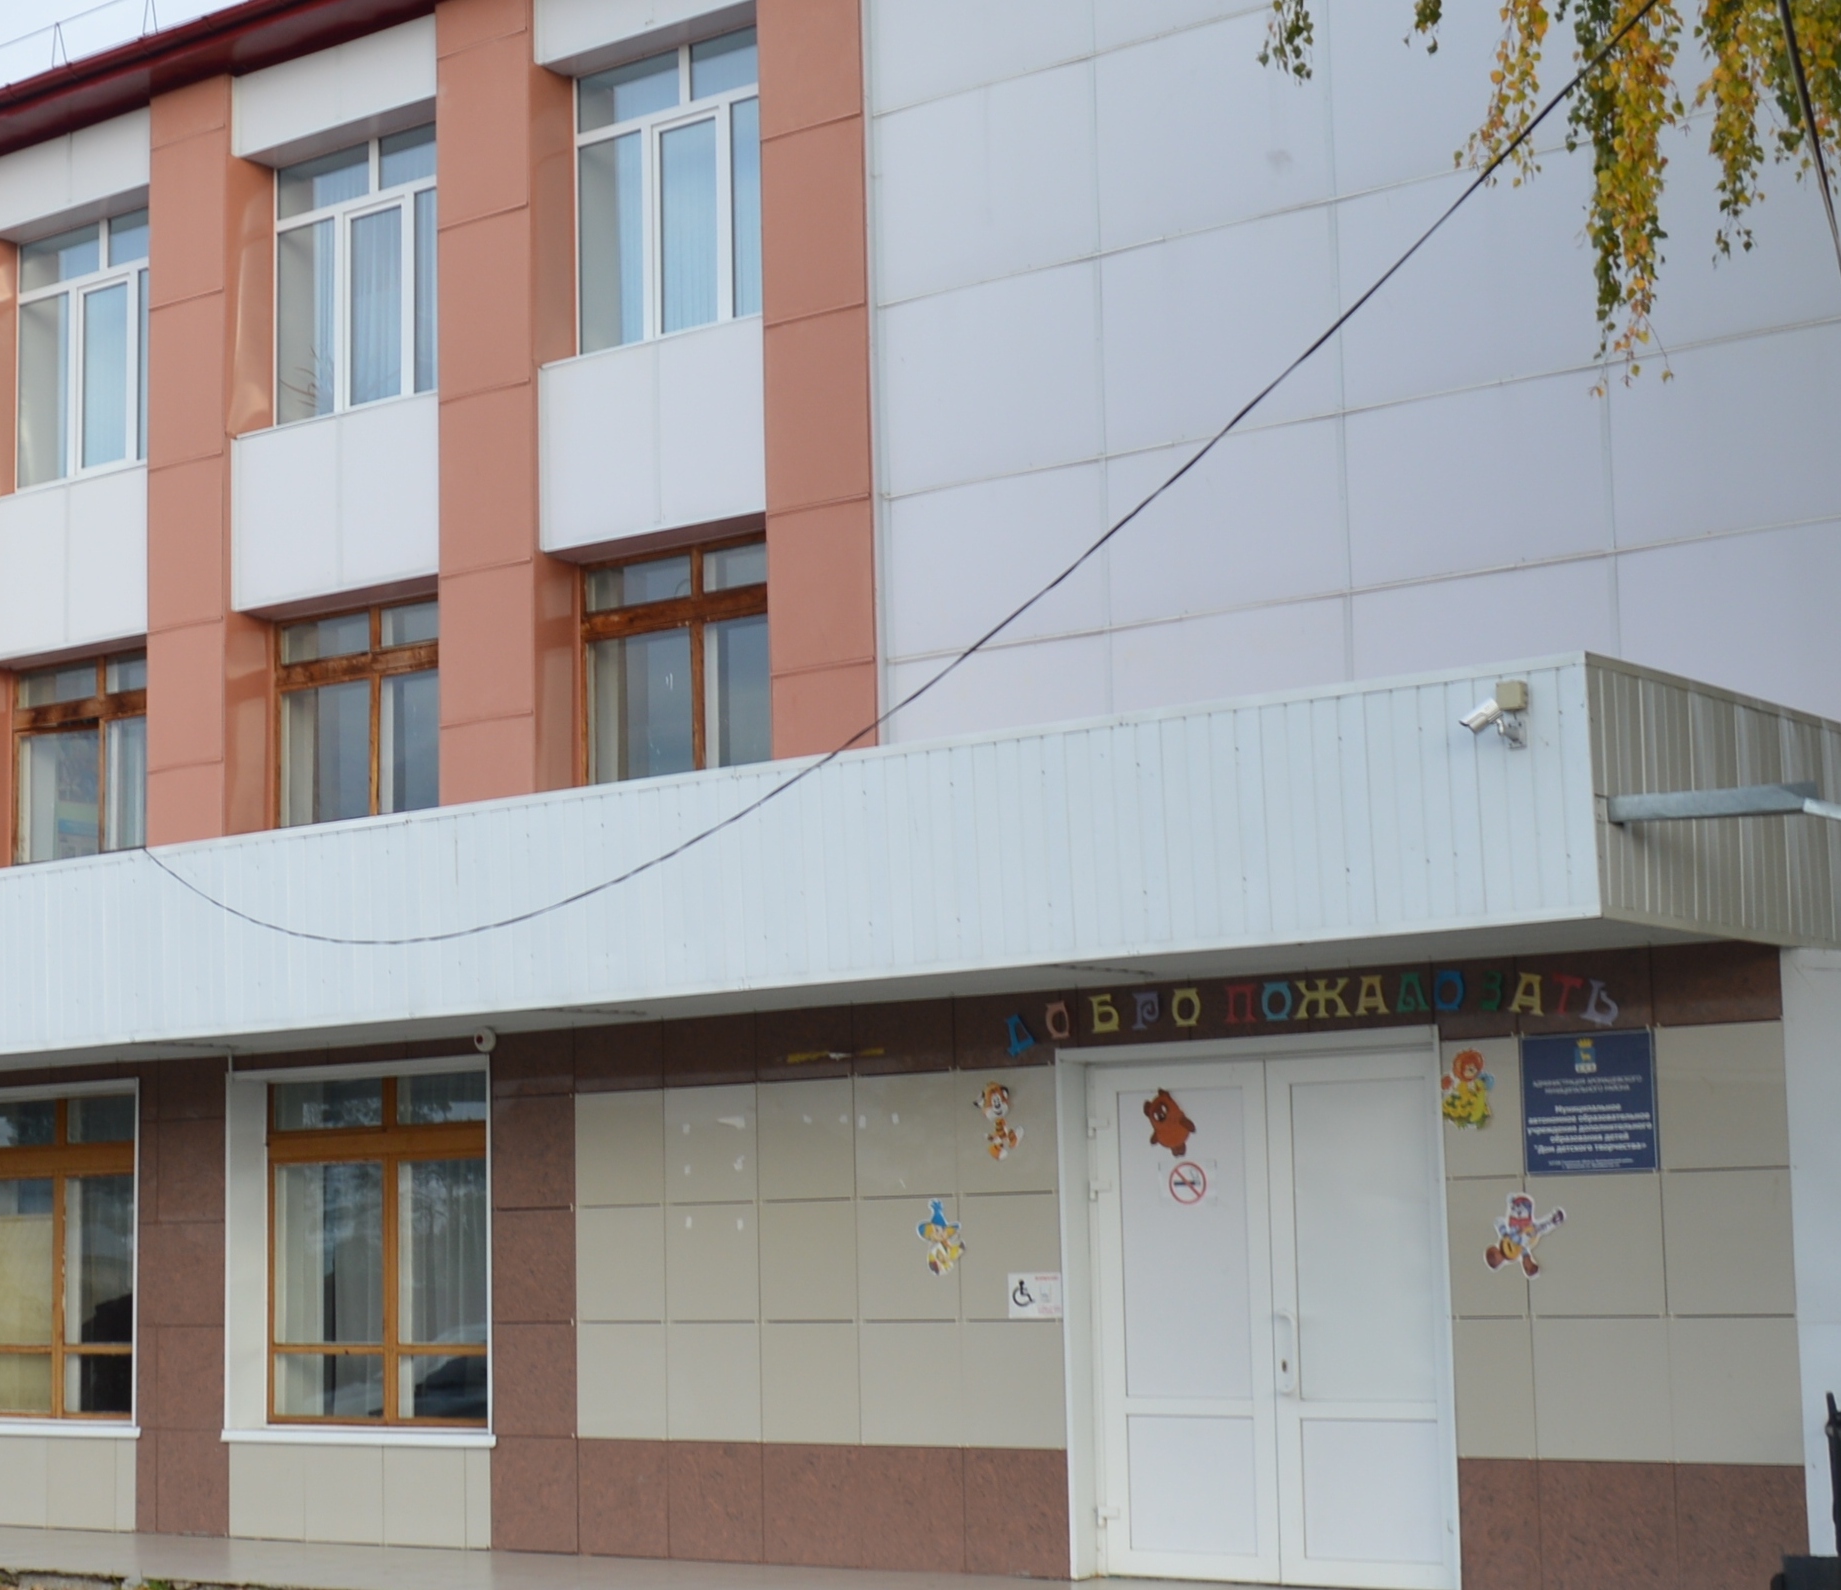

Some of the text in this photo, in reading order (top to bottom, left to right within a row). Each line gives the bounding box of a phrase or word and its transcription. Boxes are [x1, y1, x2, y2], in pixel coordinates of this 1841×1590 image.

[1005, 987, 1202, 1057] ДОБРО
[1555, 1103, 1622, 1114] Муниципальное
[1578, 1112, 1650, 1124] образовательное
[1550, 1132, 1630, 1143] образования детей
